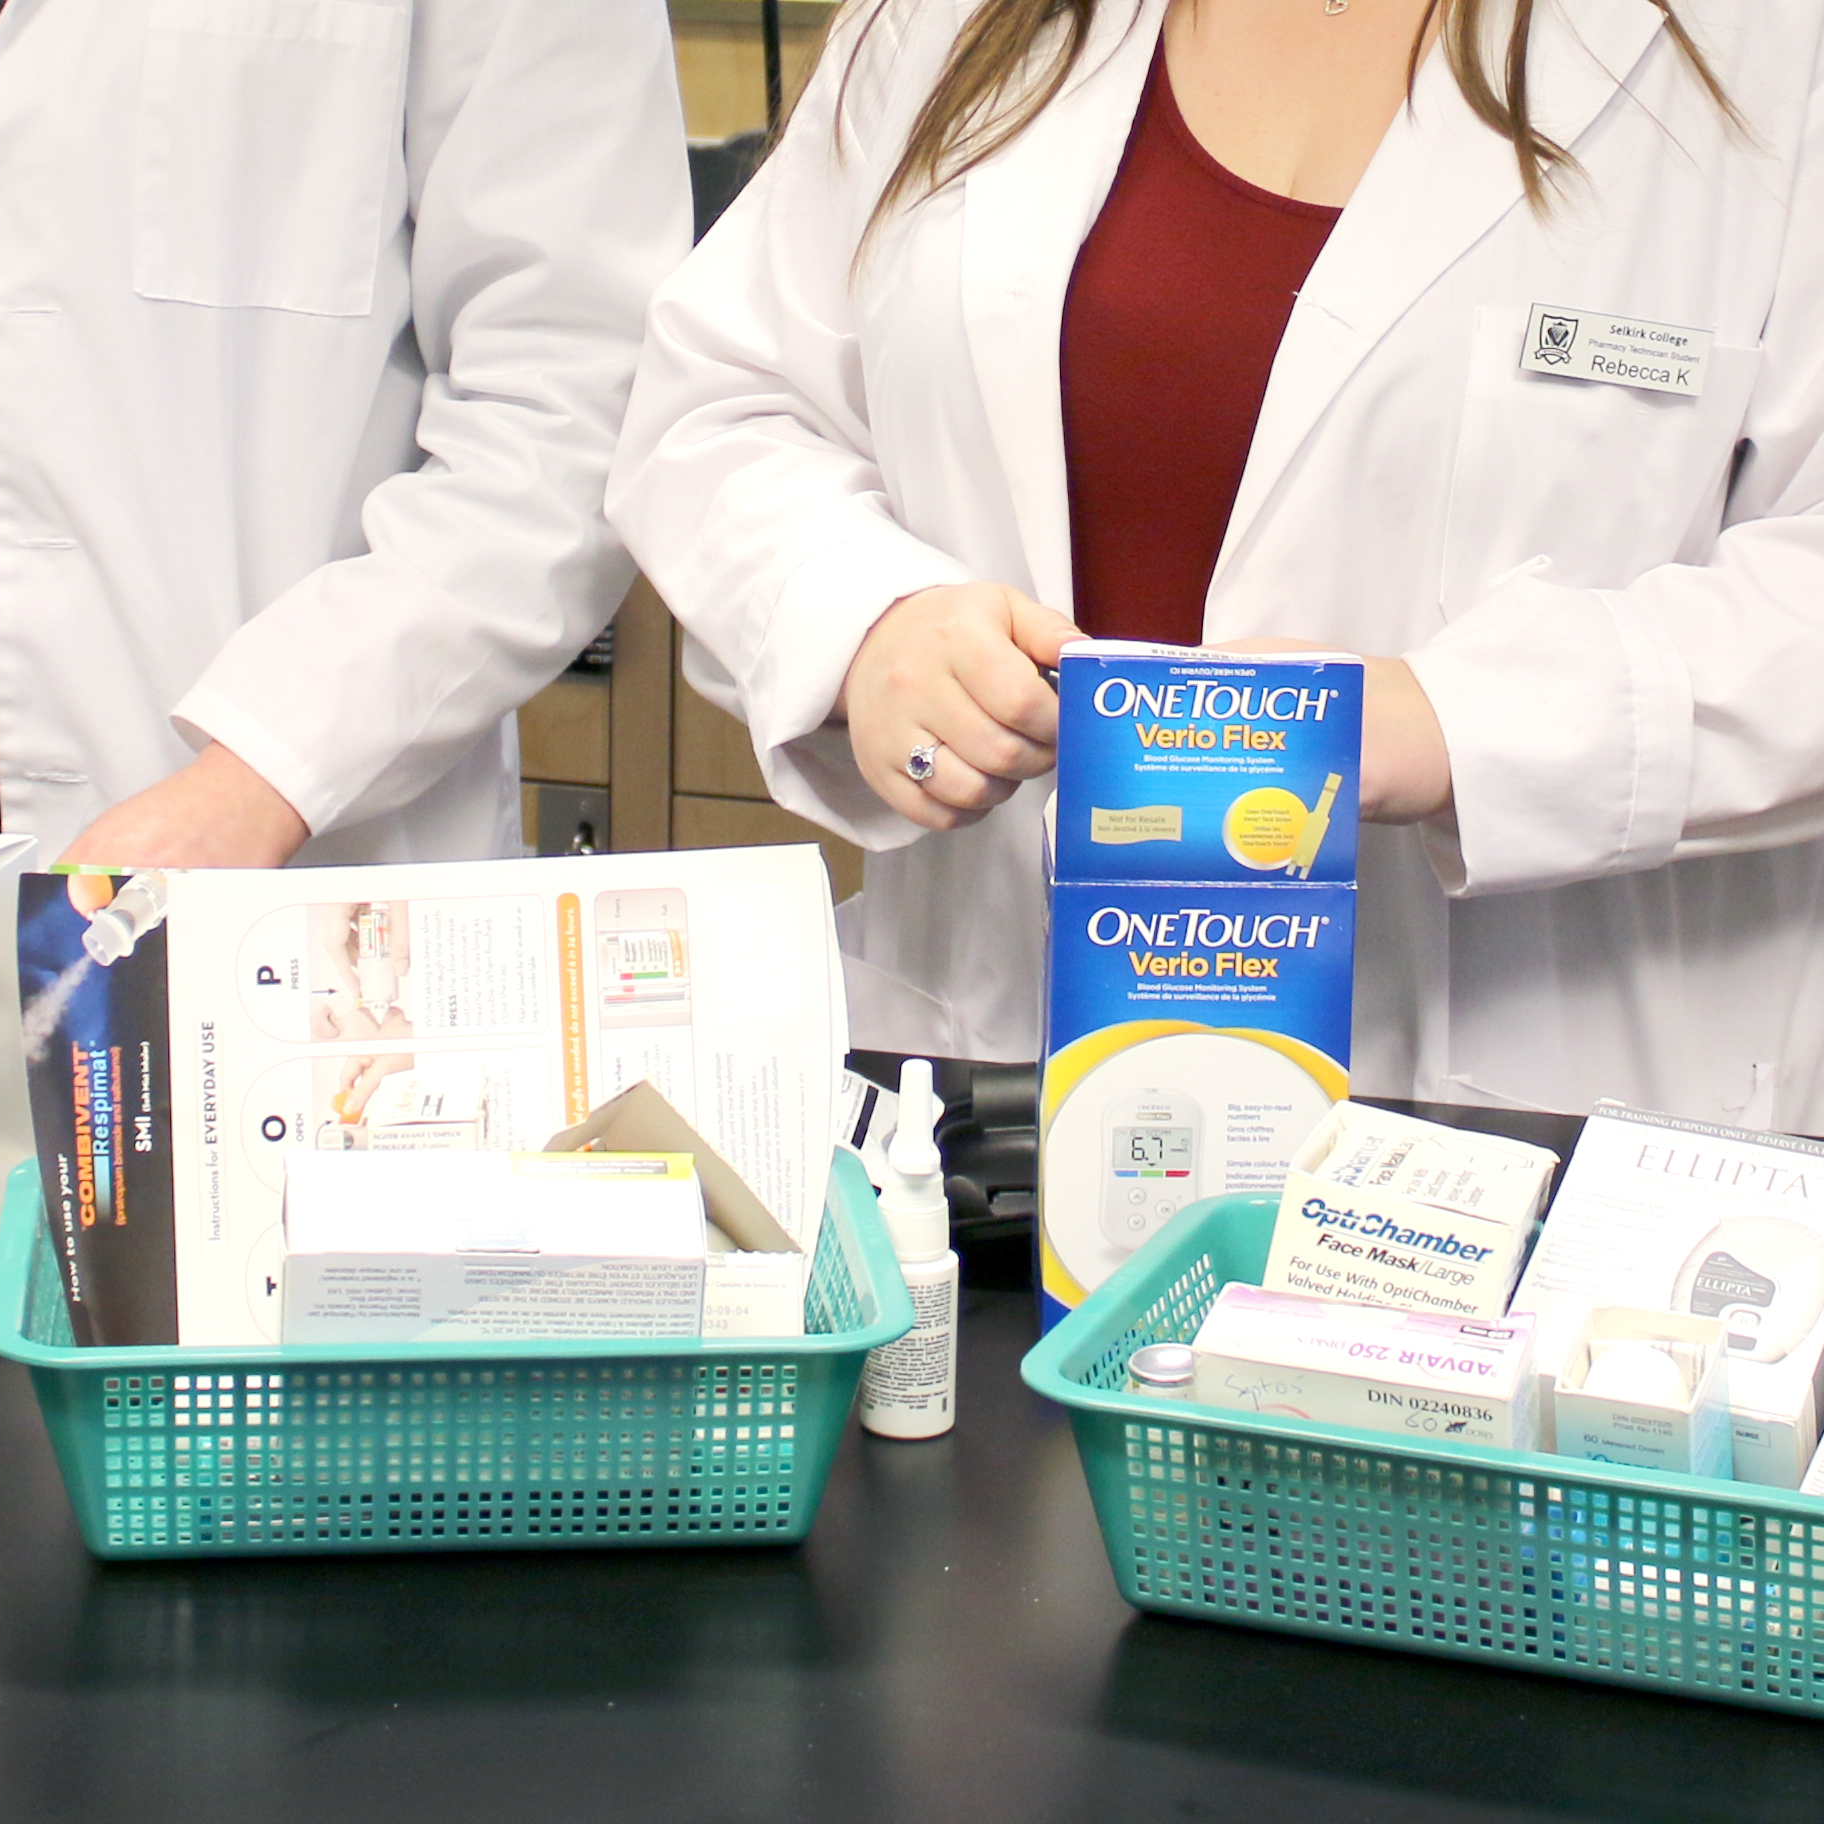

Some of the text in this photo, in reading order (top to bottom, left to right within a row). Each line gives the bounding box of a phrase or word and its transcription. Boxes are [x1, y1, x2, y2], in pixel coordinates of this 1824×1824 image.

[1610, 324, 1688, 346] Selkirk College
[1588, 339, 1701, 364] Pharmacy Technician Student
[1591, 354, 1691, 386] Rebecca K
[1135, 723, 1286, 751] Verio Flex
[1134, 763, 1170, 773] Système
[1169, 764, 1180, 773] de
[1180, 764, 1227, 773] surveillance
[1228, 765, 1238, 773] de
[1240, 765, 1247, 773] la
[1144, 754, 1275, 766] Blood Glucose Monitoring System
[1109, 814, 1166, 824] Not for Resale
[565, 907, 575, 935] hours.
[567, 950, 576, 959] in
[1129, 951, 1278, 978] Verio Flex
[256, 965, 282, 986] P
[290, 958, 299, 990] PRESS
[567, 969, 578, 1002] exceed
[1127, 992, 1163, 1002] Système
[1173, 993, 1219, 1001] surveillance
[1221, 993, 1231, 1001] de
[1232, 993, 1239, 1001] la
[1137, 983, 1267, 994] Blood Glucose Monitoring System
[569, 1004, 579, 1019] not
[569, 1022, 579, 1034] do
[574, 1075, 582, 1086] as
[90, 1049, 113, 1155] Respimat
[571, 1088, 584, 1112] puffs
[1244, 1104, 1292, 1112] easy-to-read
[261, 1115, 286, 1142] O
[296, 1113, 304, 1142] OPEN
[1228, 1113, 1261, 1121] numbers
[73, 1045, 96, 1227] COMBIVENT
[135, 1115, 153, 1153] SMI
[202, 1021, 221, 1241] Instructions for EVERYDAY USE
[1598, 1107, 1620, 1119] FOR
[1621, 1110, 1669, 1127] TRAINING
[1671, 1117, 1719, 1135] PURPOSES
[1720, 1126, 1747, 1140] ONLY
[1807, 1143, 1821, 1154] LA
[1132, 1137, 1163, 1161] 6.7
[1636, 1143, 1811, 1200] ELLIPTA
[58, 1153, 81, 1302] How to use your
[1301, 1198, 1494, 1263] OptiChamber
[1317, 1233, 1475, 1286] Face Mask/Large
[1287, 1272, 1332, 1296] Valved
[1290, 1256, 1313, 1274] For
[1315, 1262, 1341, 1280] Use
[1346, 1269, 1378, 1290] With
[1382, 1281, 1479, 1315] OptiChamber
[1696, 1277, 1753, 1297] ELLIPTA
[1349, 1342, 1390, 1361] 250
[1367, 1389, 1493, 1422] DIN 02240836
[1584, 1433, 1599, 1444] 60
